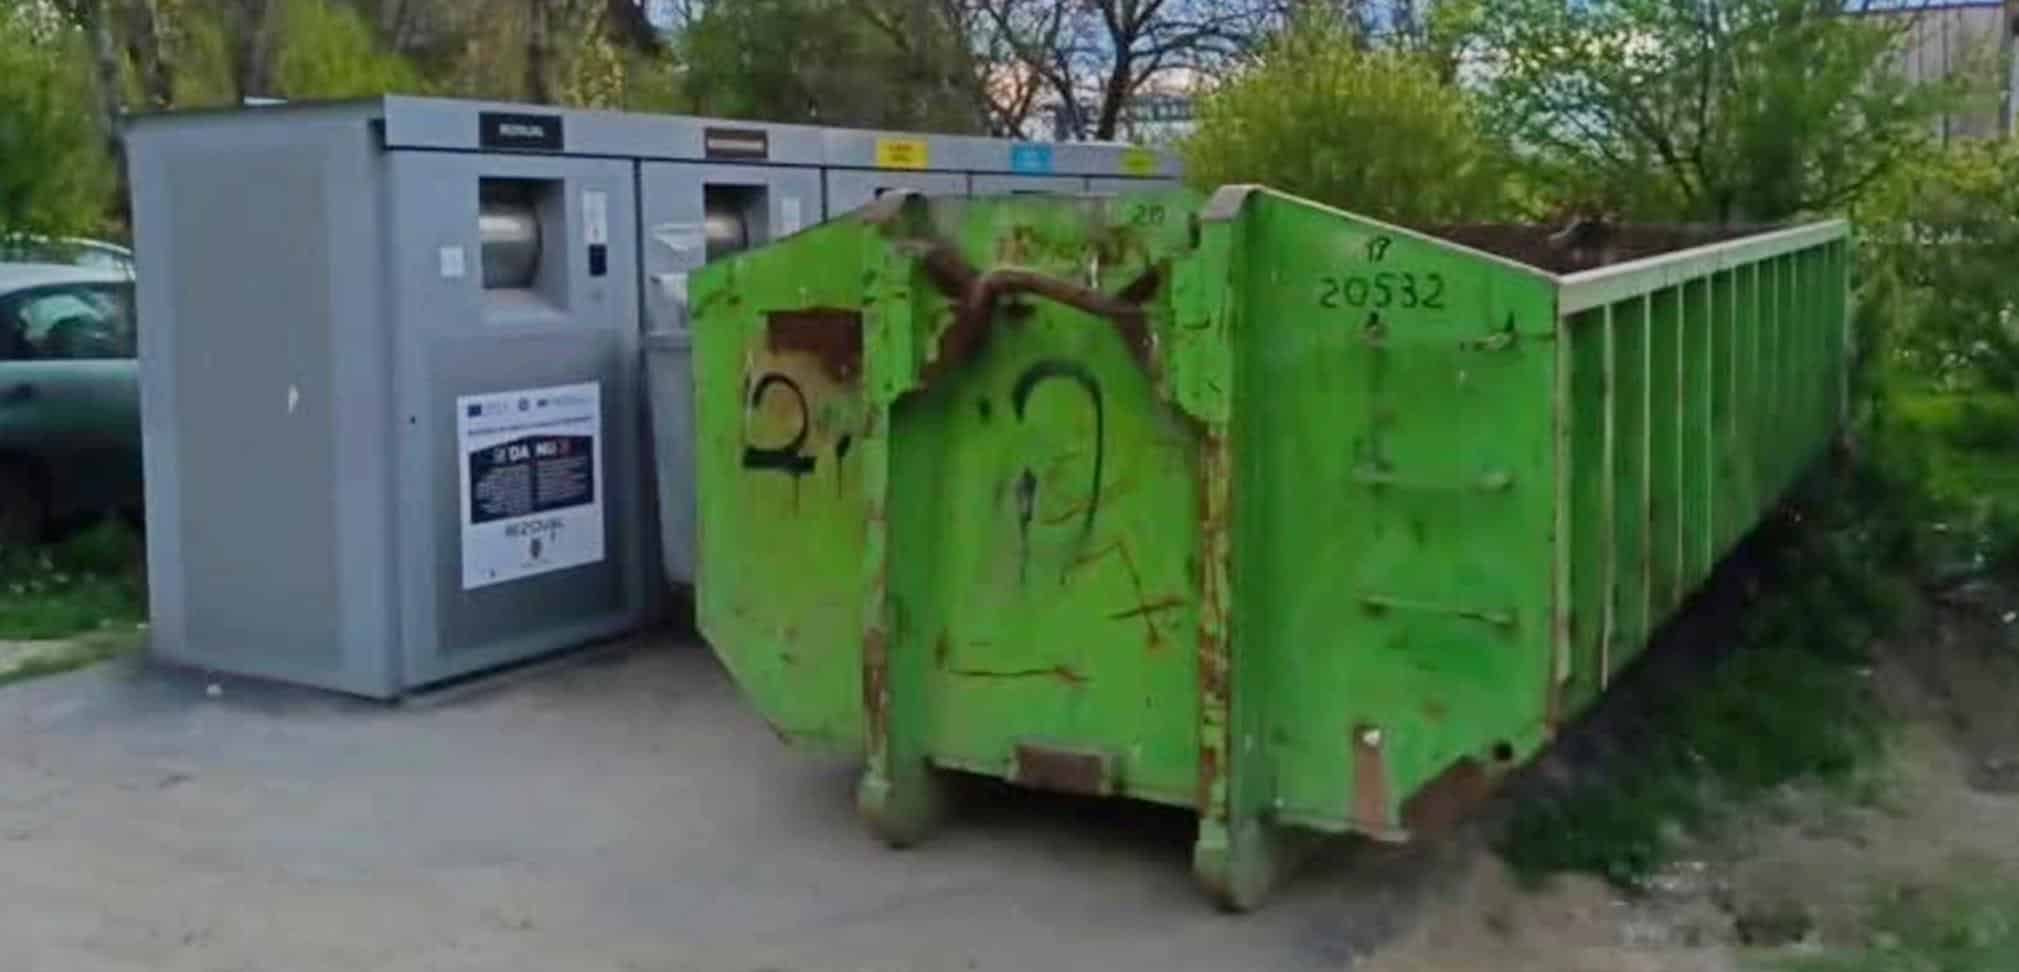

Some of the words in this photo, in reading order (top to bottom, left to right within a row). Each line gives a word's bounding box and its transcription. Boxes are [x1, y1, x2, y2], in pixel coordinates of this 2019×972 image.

[1319, 271, 1446, 310] 20532
[509, 443, 530, 461] DA
[536, 440, 558, 457] NU
